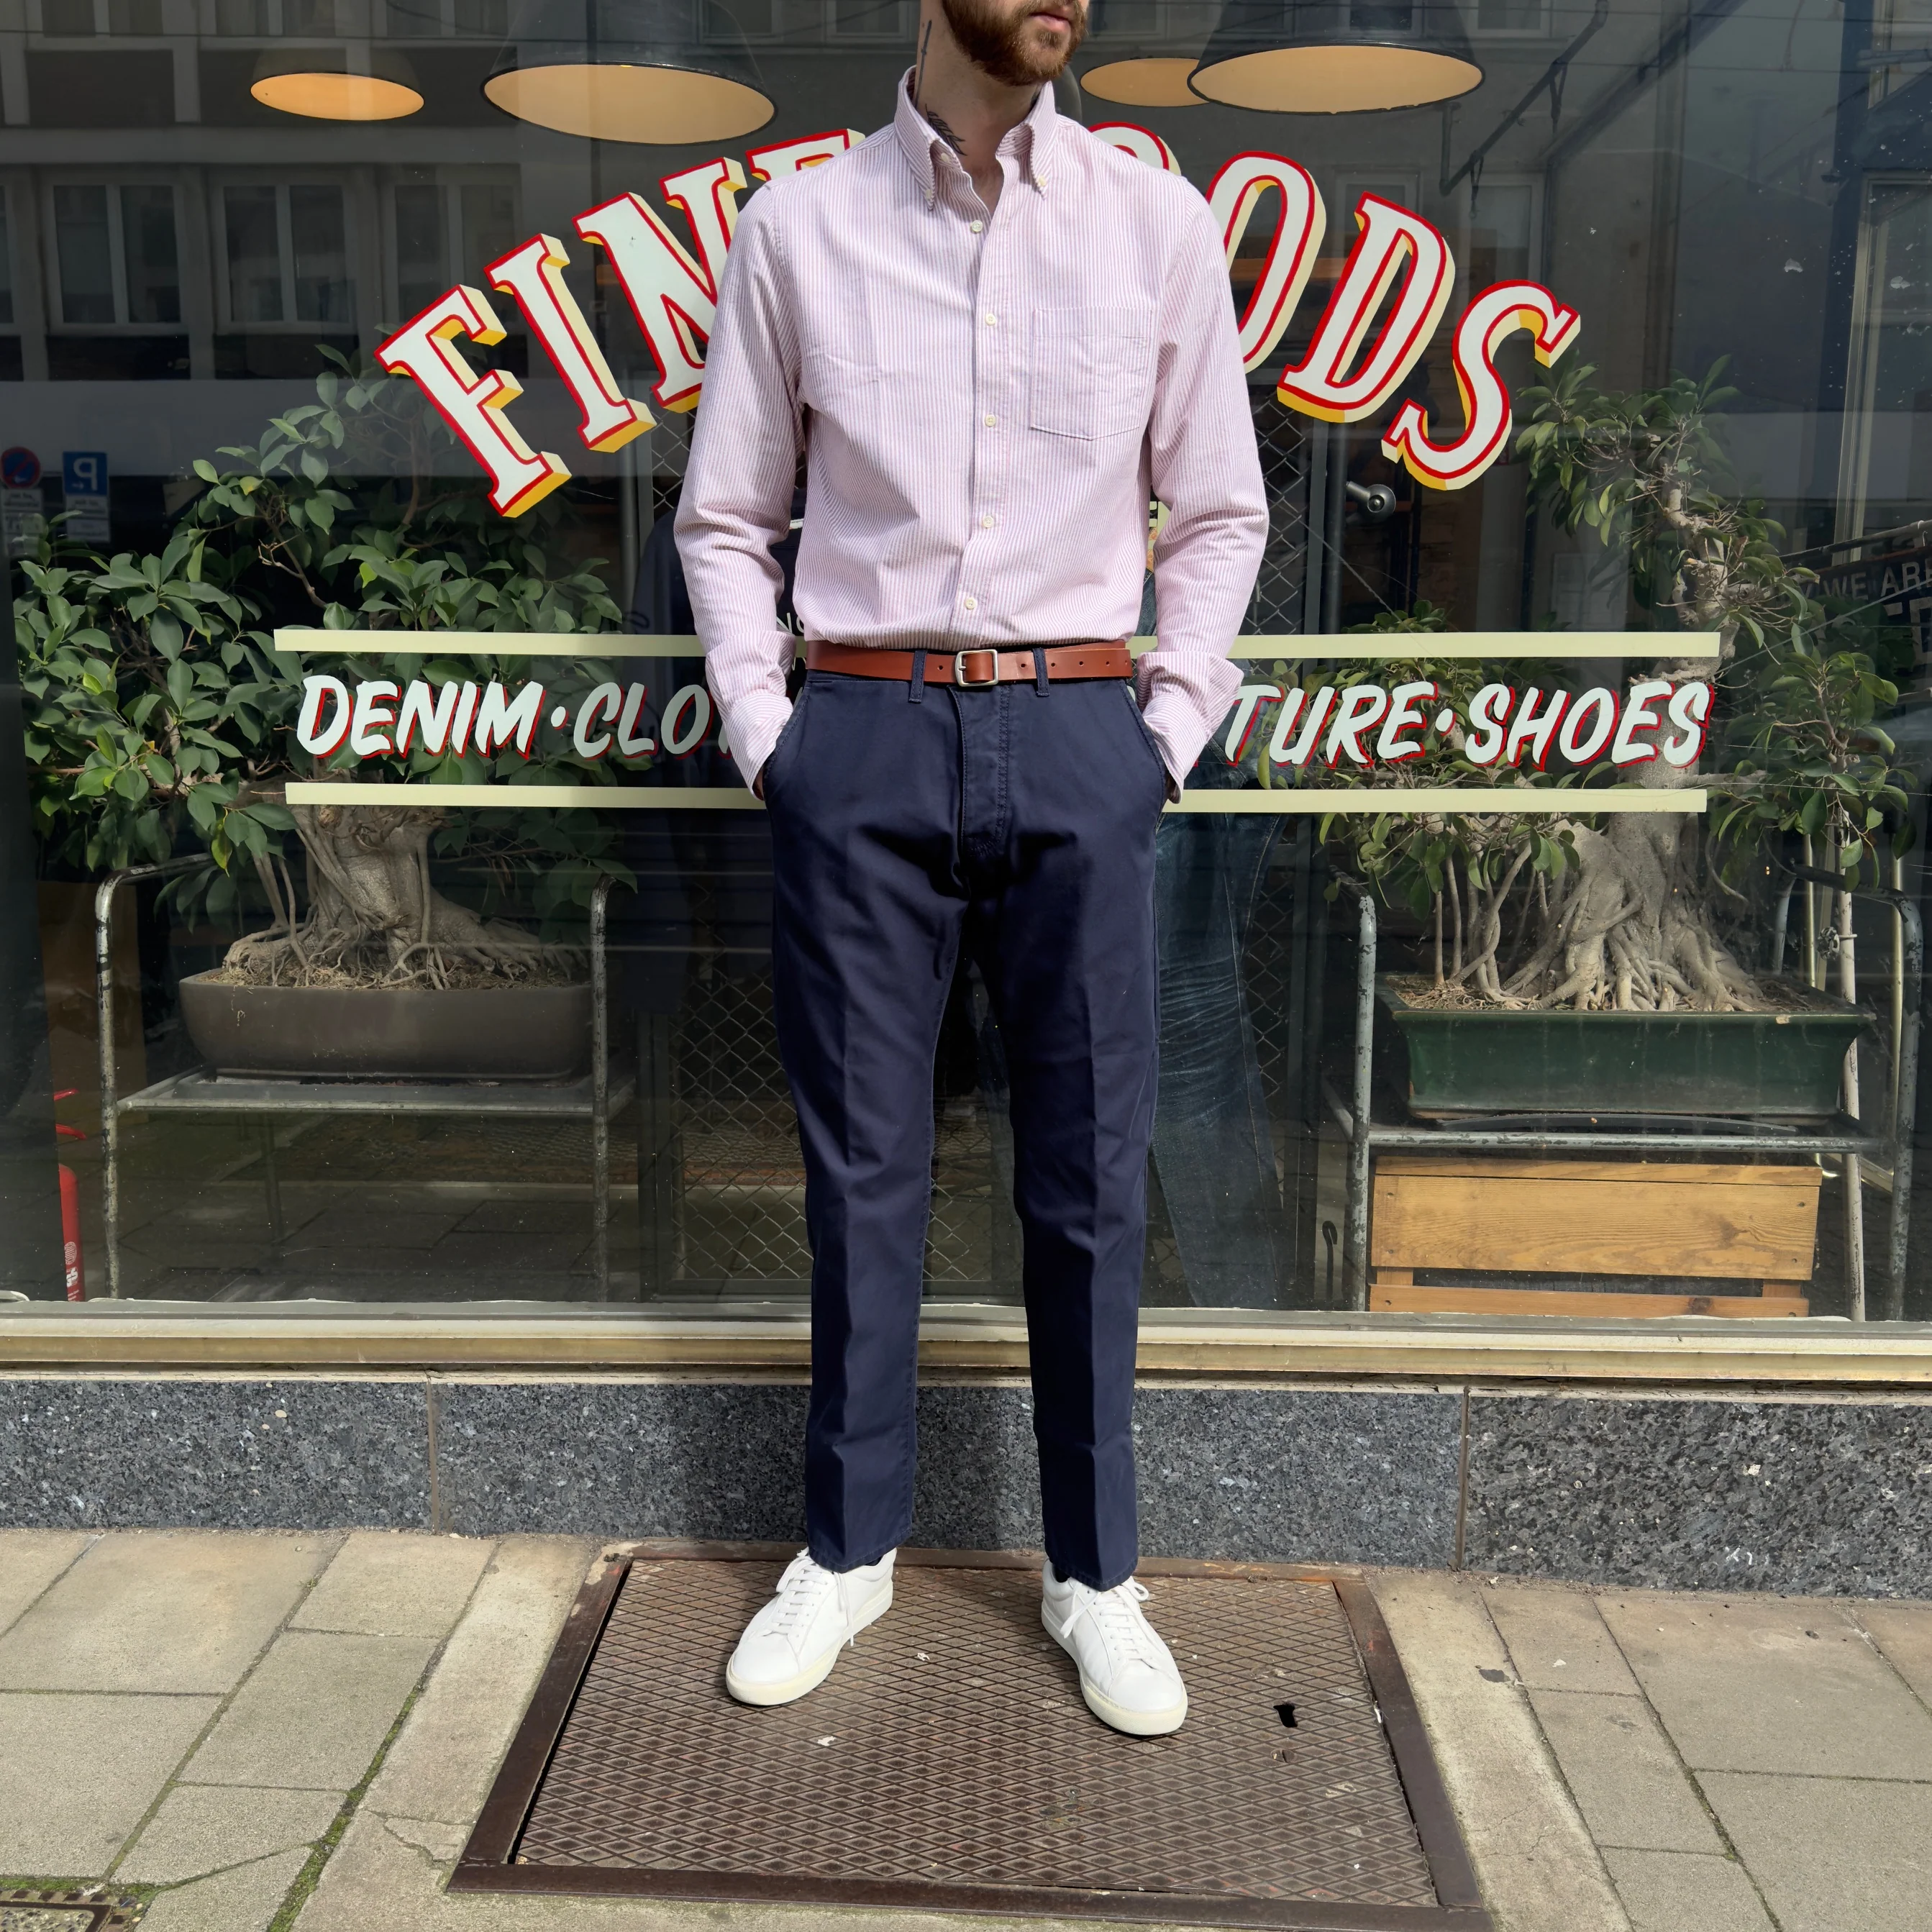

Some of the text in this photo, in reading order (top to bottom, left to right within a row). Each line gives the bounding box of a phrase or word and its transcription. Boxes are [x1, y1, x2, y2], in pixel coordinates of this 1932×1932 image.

[374, 122, 1580, 518] FIN ODS
[296, 675, 1714, 773] DENIM CLO TURE SHOES
